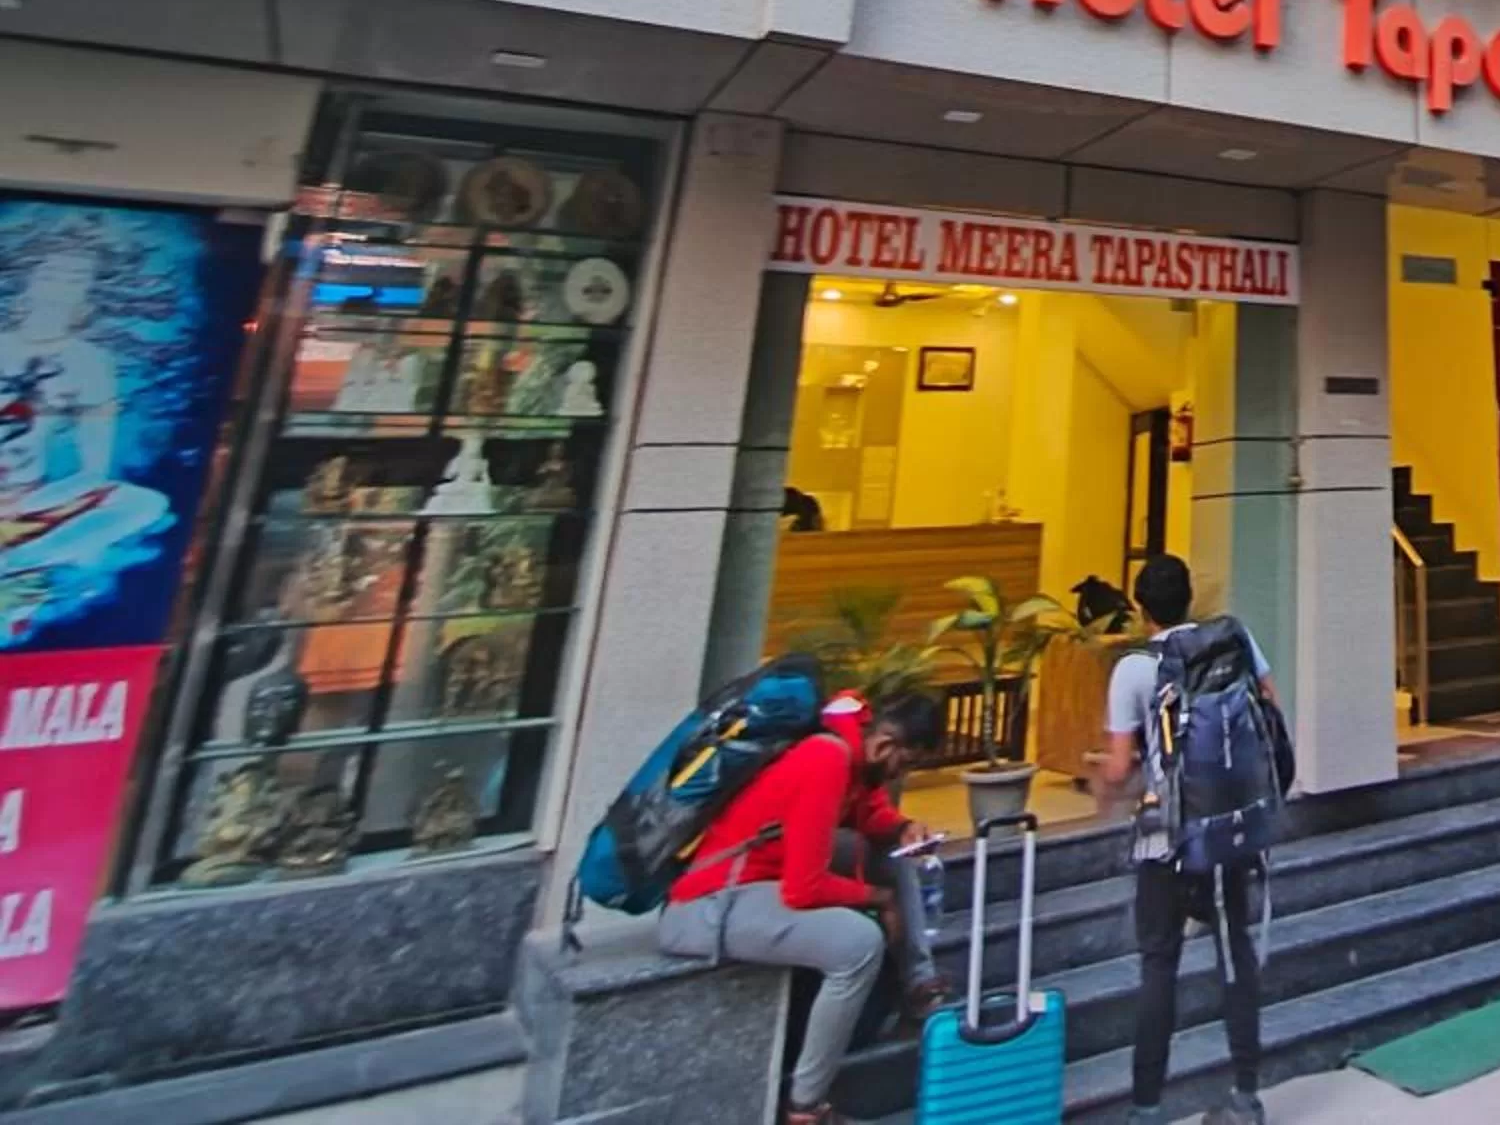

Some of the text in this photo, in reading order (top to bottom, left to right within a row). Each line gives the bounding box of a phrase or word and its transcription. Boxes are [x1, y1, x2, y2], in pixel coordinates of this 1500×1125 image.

[771, 204, 1289, 297] HOTEL MEERA TAPASTHALI
[0, 680, 128, 750] MALA
